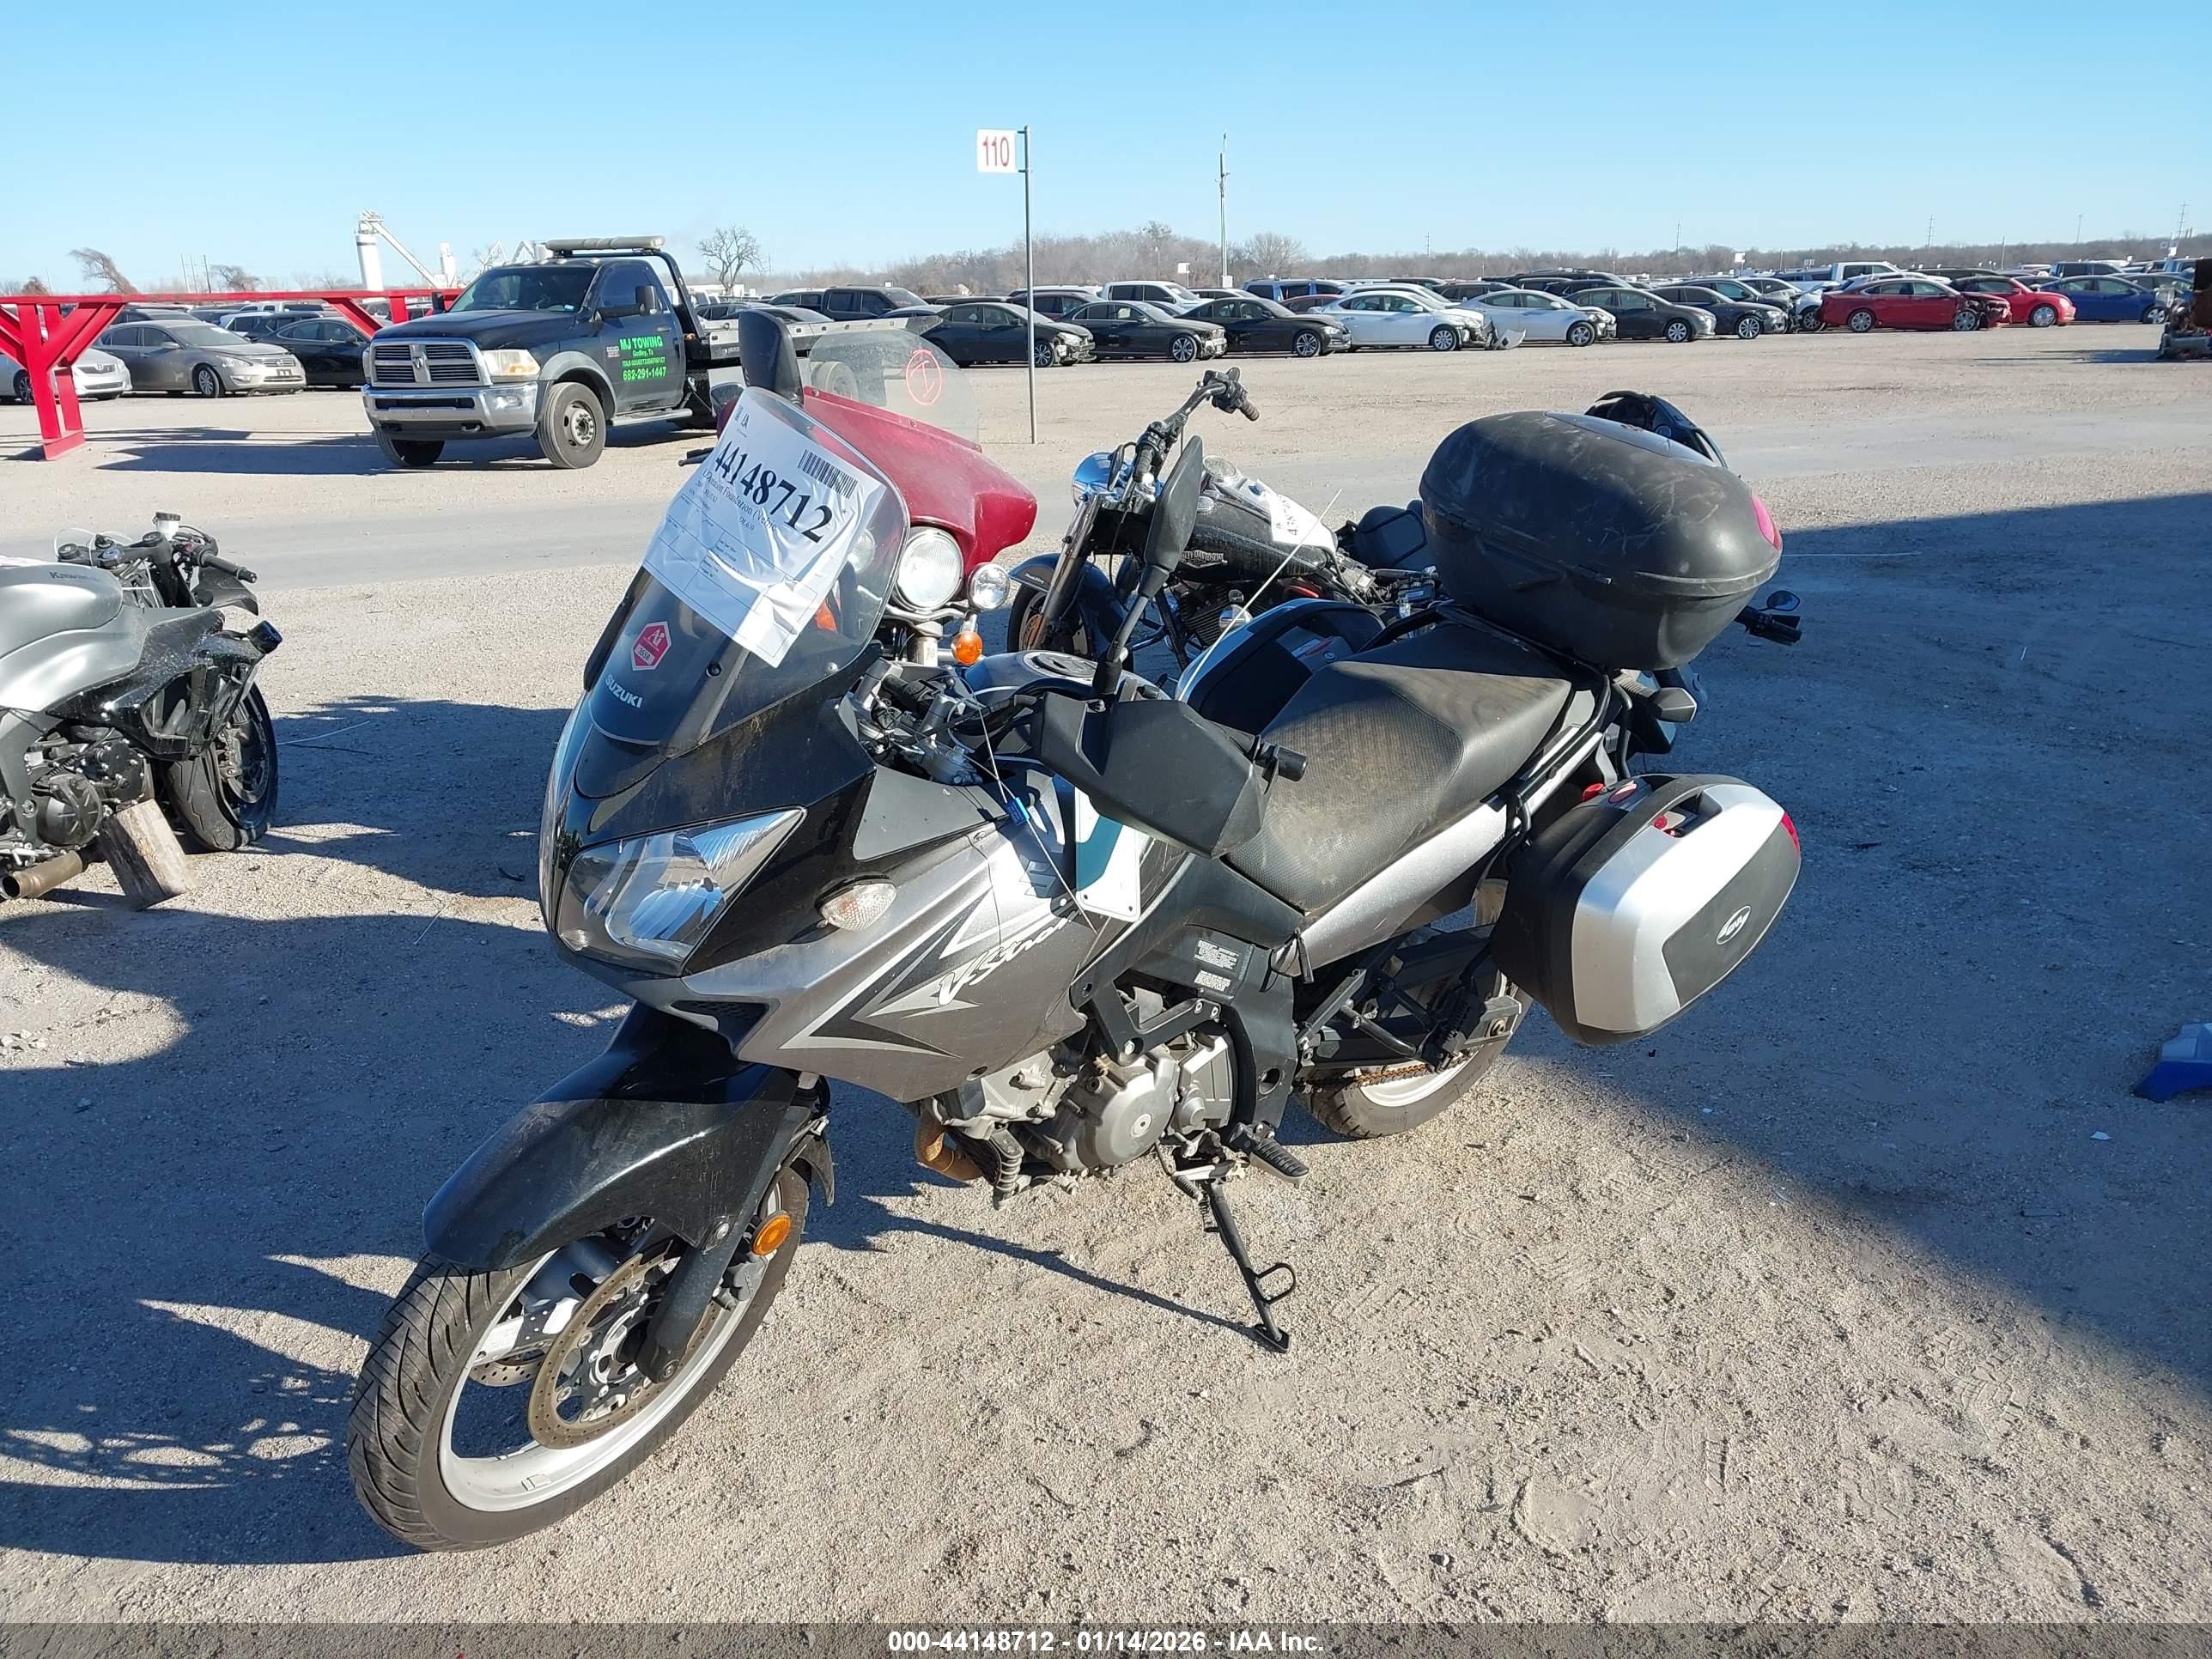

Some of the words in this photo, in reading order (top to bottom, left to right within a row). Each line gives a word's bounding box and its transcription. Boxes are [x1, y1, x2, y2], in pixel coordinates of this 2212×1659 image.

[982, 136, 1010, 167] 110
[619, 338, 632, 350] MJ
[631, 335, 664, 349] TOWING
[714, 440, 834, 544] 44148712
[605, 673, 644, 708] SUZUKI
